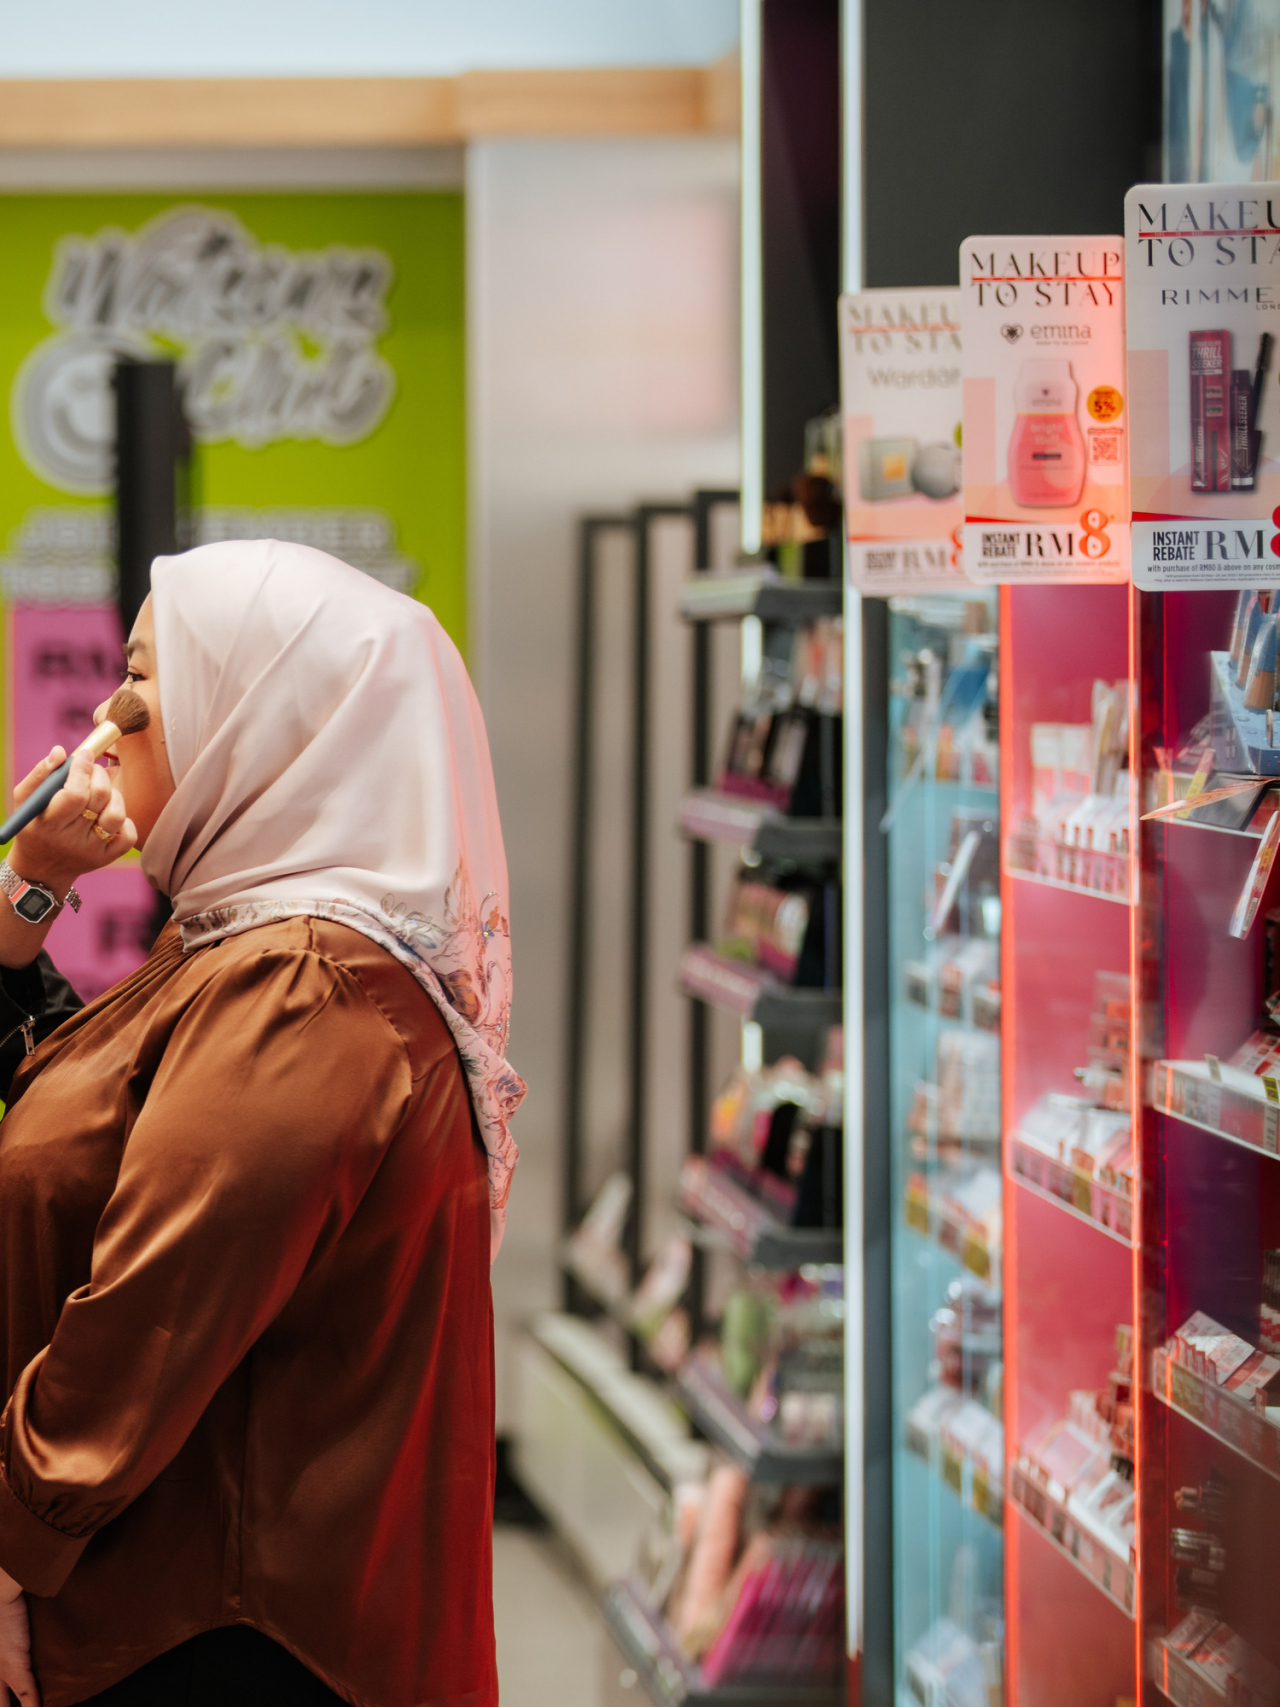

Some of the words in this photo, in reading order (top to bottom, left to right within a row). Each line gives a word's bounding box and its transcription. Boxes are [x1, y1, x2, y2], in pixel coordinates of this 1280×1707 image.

[1138, 238, 1194, 266] TO
[972, 252, 1120, 276] MAKEUP
[971, 282, 1017, 307] TO
[1035, 282, 1120, 307] STAY
[1030, 323, 1092, 339] emina
[1192, 346, 1222, 359] THRILL
[1192, 359, 1222, 369] SEEKER
[982, 532, 1019, 544] INSTANT
[1153, 531, 1199, 546] INSTANT
[982, 545, 1017, 558] REBATE
[1153, 546, 1195, 561] REBATE
[1147, 565, 1161, 573] with
[1163, 564, 1190, 573] purchase
[1252, 564, 1264, 572] any
